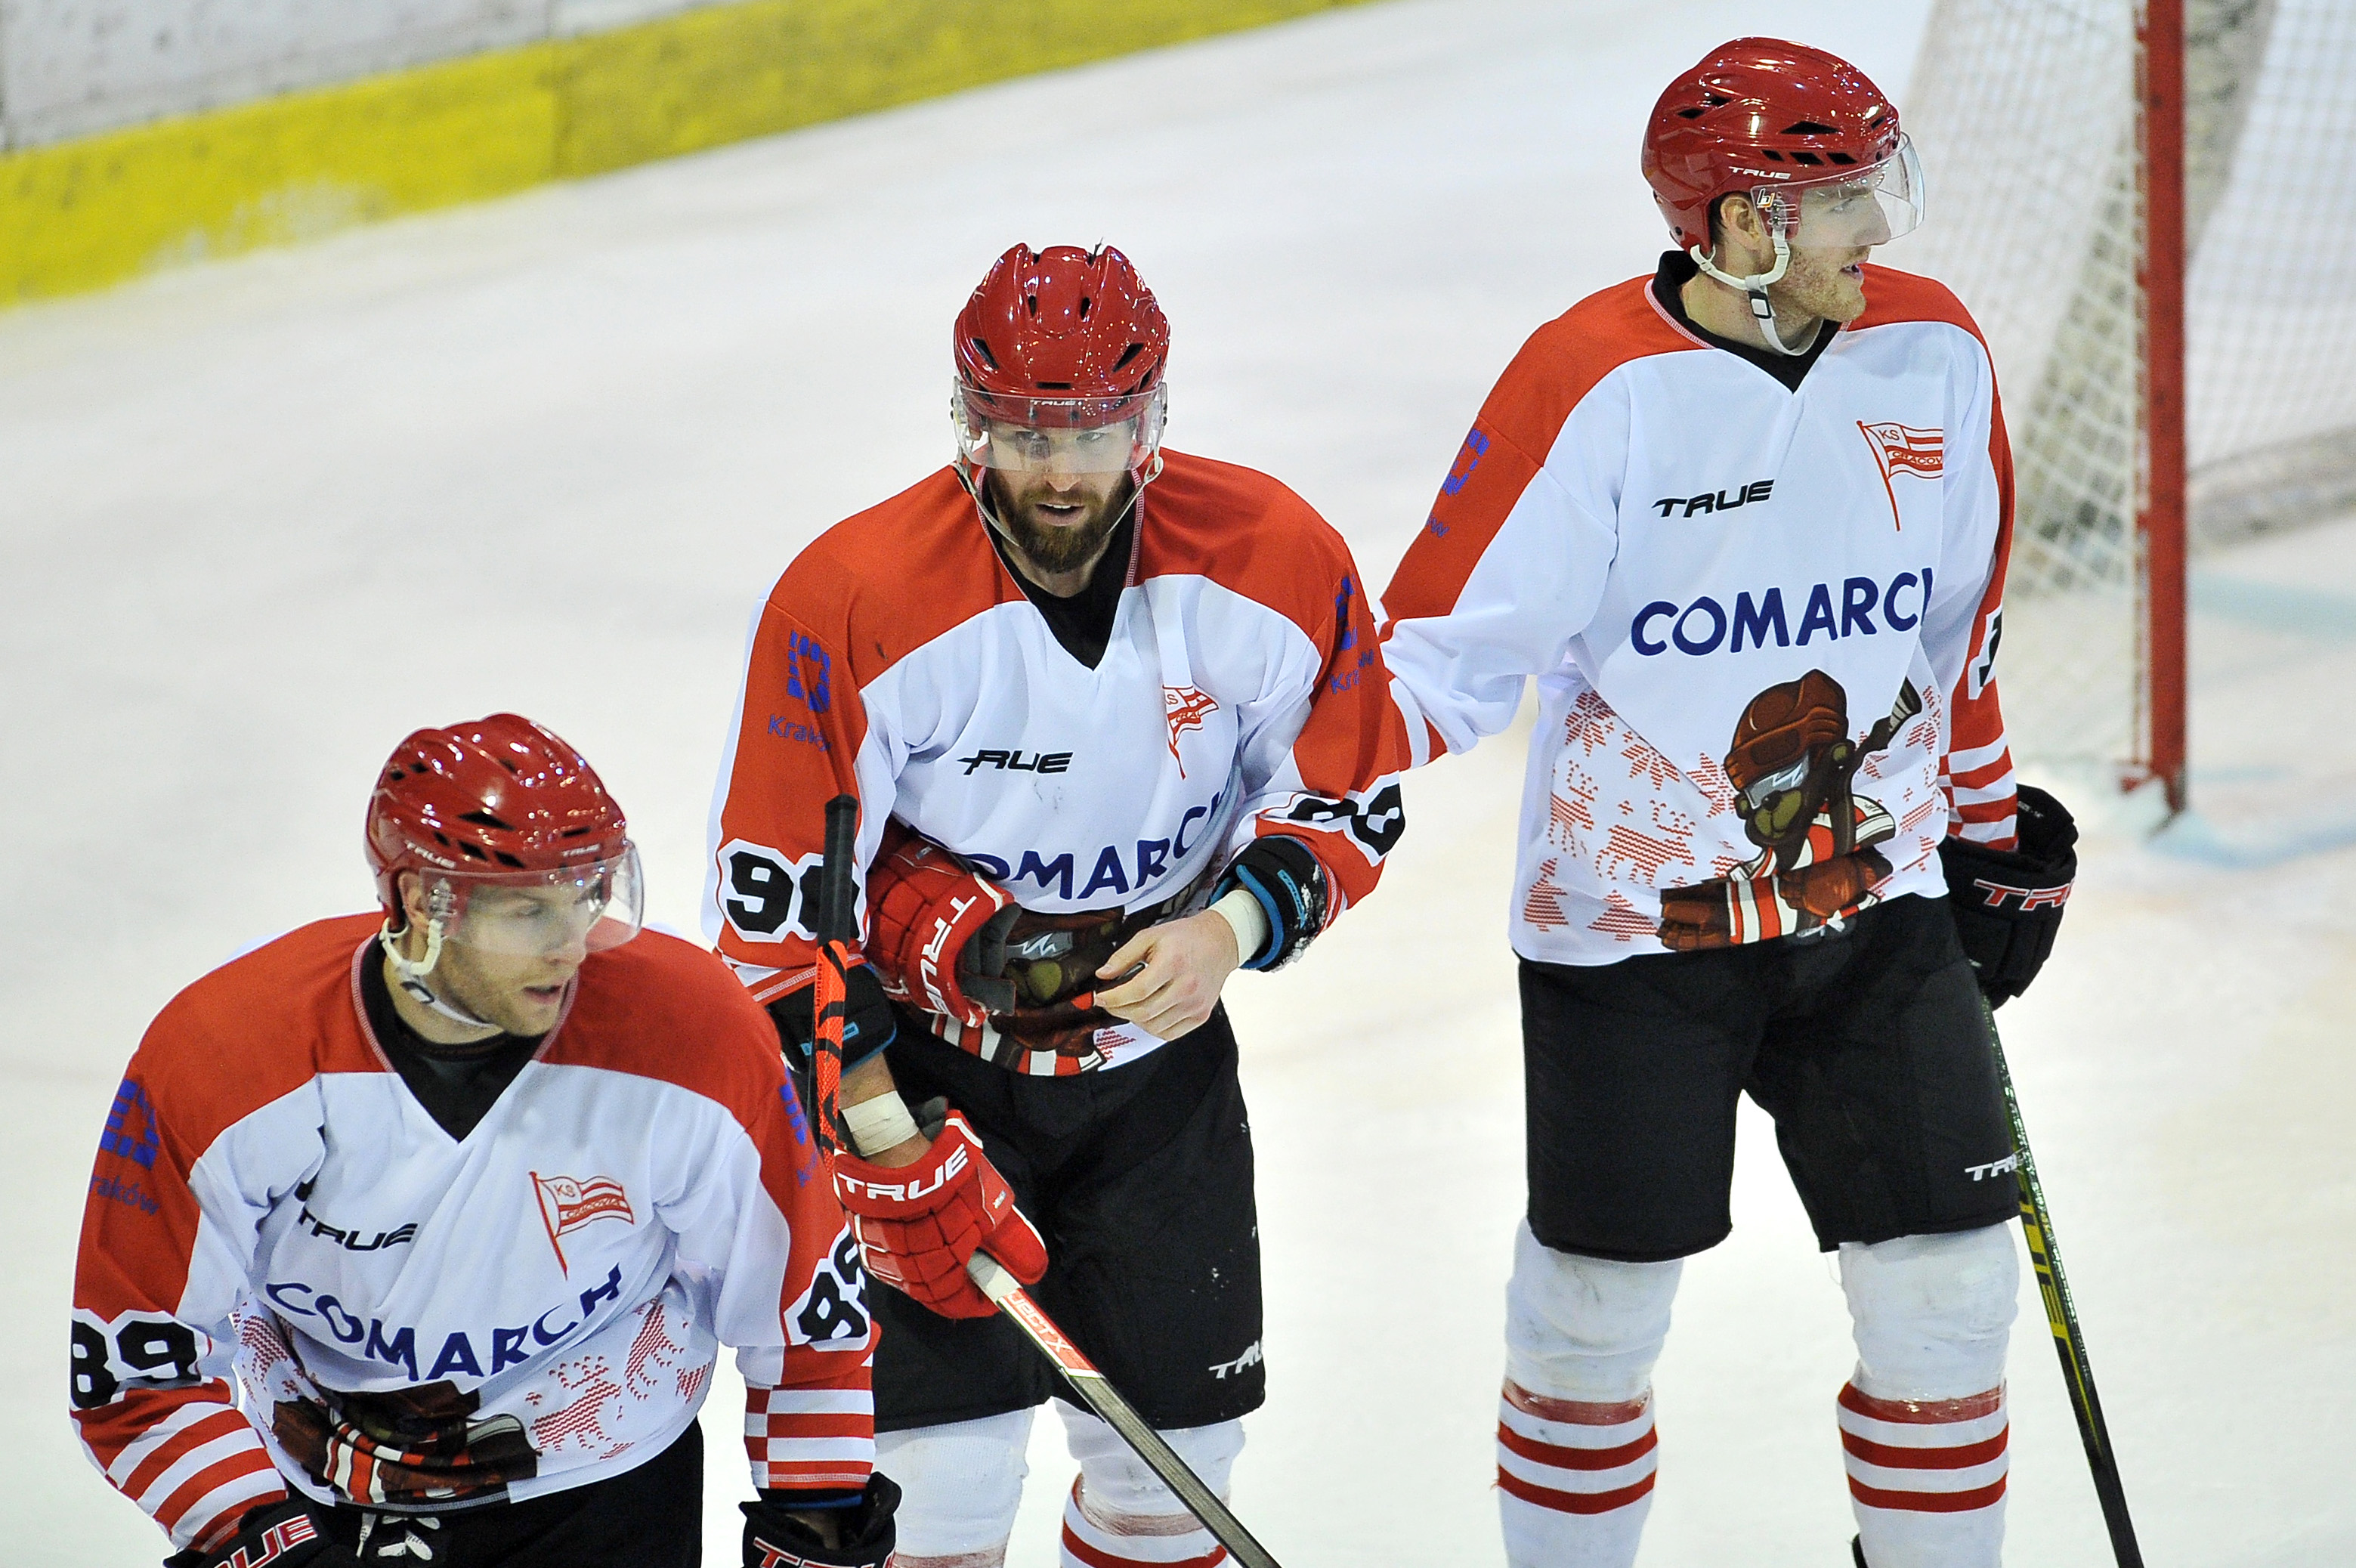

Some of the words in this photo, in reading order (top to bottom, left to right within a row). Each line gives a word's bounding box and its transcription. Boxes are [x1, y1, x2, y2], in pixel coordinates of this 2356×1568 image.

[1728, 165, 1792, 180] TRUE
[1878, 429, 1900, 441] KS
[1892, 451, 1942, 465] CRACOV
[1651, 479, 1775, 518] TRUE
[404, 839, 456, 868] TRUE
[561, 843, 601, 857] TRUE
[1973, 878, 2073, 911] TR
[920, 895, 977, 1018] TRUE
[554, 1184, 575, 1198] KS
[837, 1143, 968, 1202] TRUE
[88, 1175, 159, 1215] raków
[266, 1263, 622, 1381] COMARCH
[1008, 1294, 1056, 1336] JECT
[70, 1319, 203, 1409] 89
[214, 1514, 318, 1568] UE
